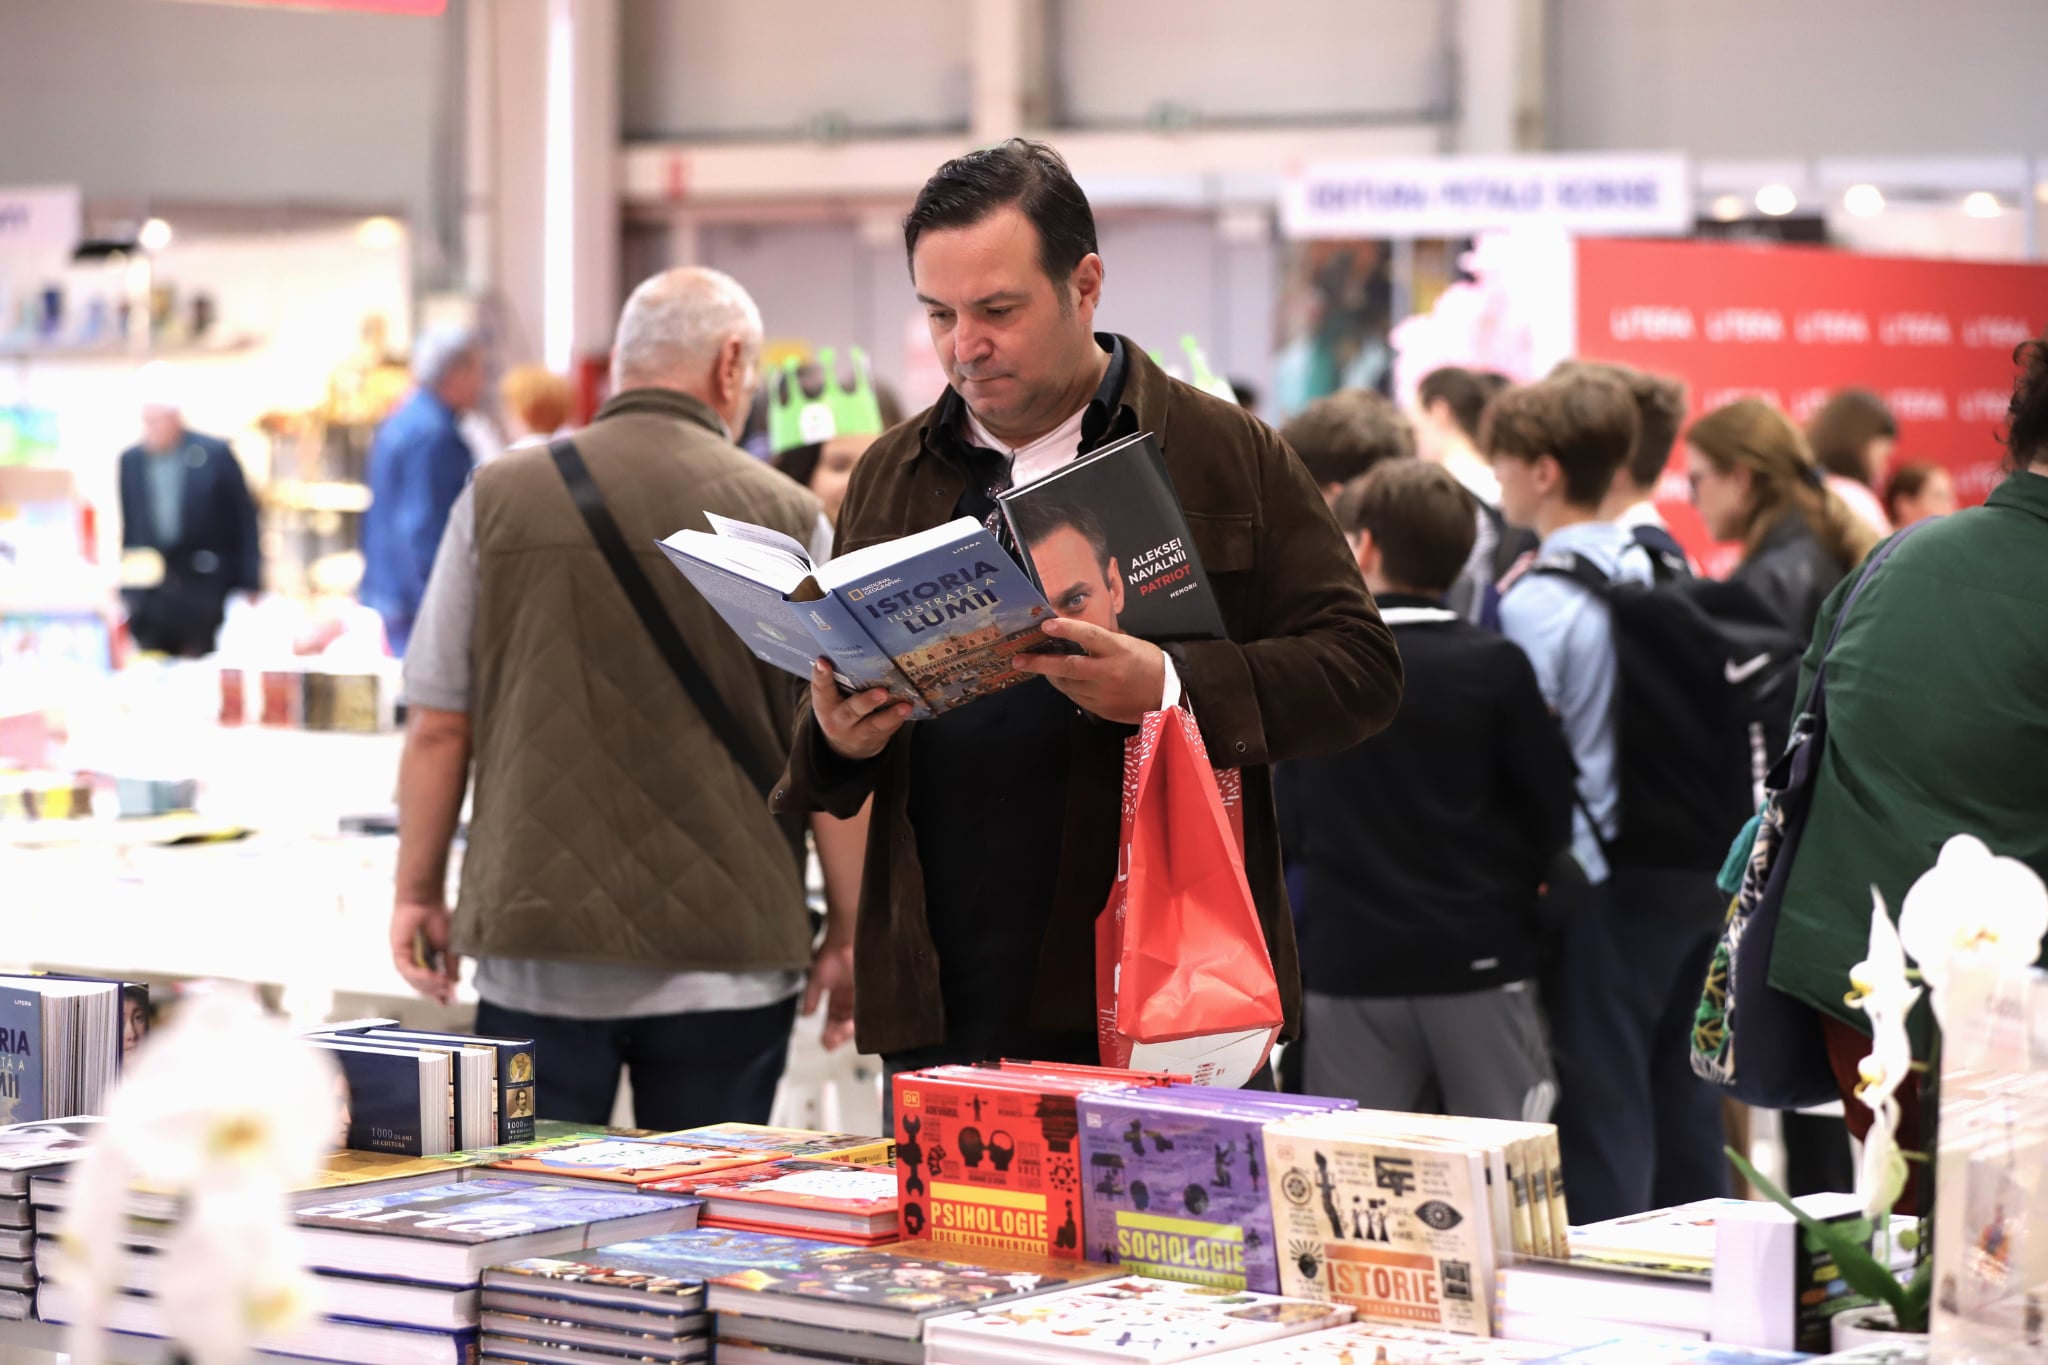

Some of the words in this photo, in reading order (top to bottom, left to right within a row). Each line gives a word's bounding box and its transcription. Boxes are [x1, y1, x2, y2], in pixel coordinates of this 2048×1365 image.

[1705, 307, 1784, 342] LITERA
[1793, 309, 1869, 344] LITERA
[1128, 549, 1187, 585] NAVALNÎI
[1132, 537, 1182, 570] ALEKSEI
[865, 560, 1000, 619] ISTORIA
[1140, 564, 1191, 597] PATRIOT
[1170, 582, 1198, 599] MEMORII
[887, 583, 977, 624] ILUSTRATĂ
[986, 578, 996, 587] A
[903, 589, 998, 635] LUMII
[372, 1127, 393, 1139] 1000
[507, 1120, 524, 1129] 1000
[930, 1201, 1048, 1238] PSIHOLOGIE
[934, 1229, 957, 1243] IDEI
[962, 1233, 1047, 1255] FUNDAMENTALE
[1117, 1228, 1246, 1272] SOCIOLOGIE
[1326, 1261, 1439, 1305] ISTORIE
